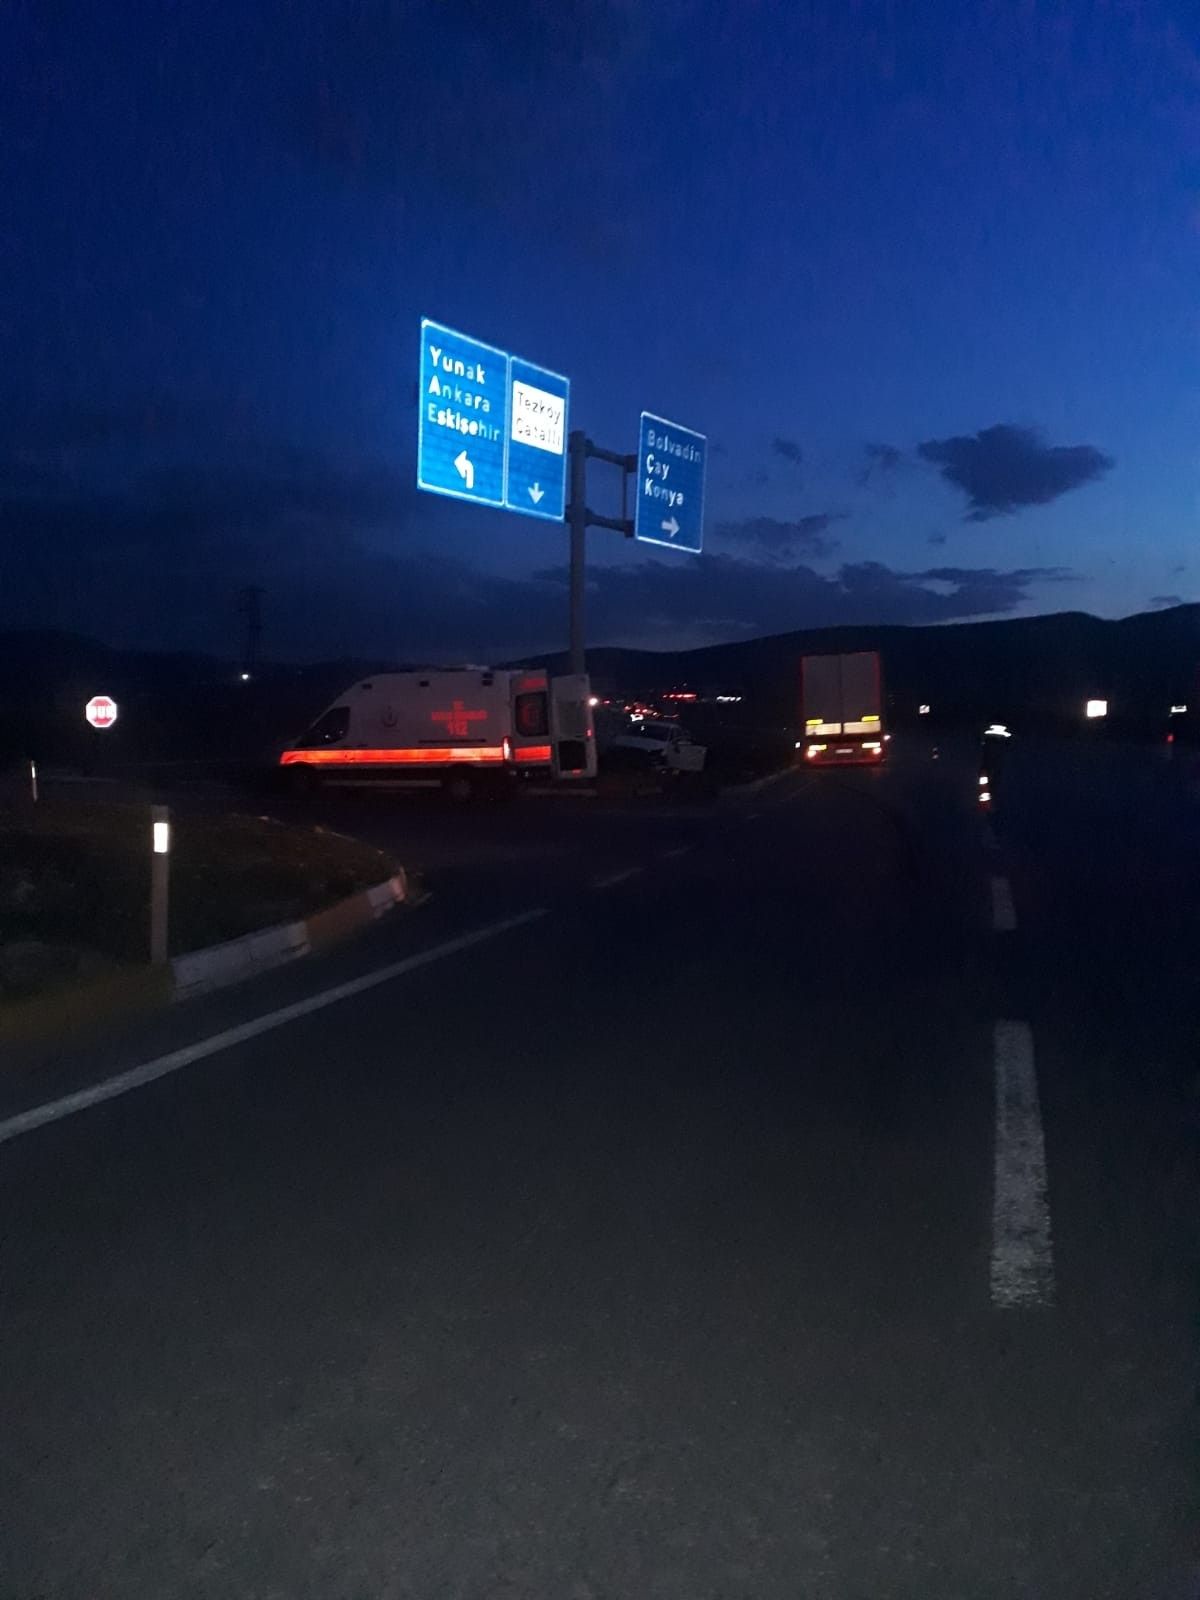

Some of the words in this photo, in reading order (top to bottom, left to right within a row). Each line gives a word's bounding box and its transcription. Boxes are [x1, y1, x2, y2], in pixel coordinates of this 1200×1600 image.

[430, 346, 485, 384] Yunak
[428, 376, 490, 412] Ankara
[428, 404, 500, 441] Eskişehir
[648, 430, 702, 463] Bolvadin
[646, 453, 670, 480] Çay
[645, 478, 684, 507] Konya
